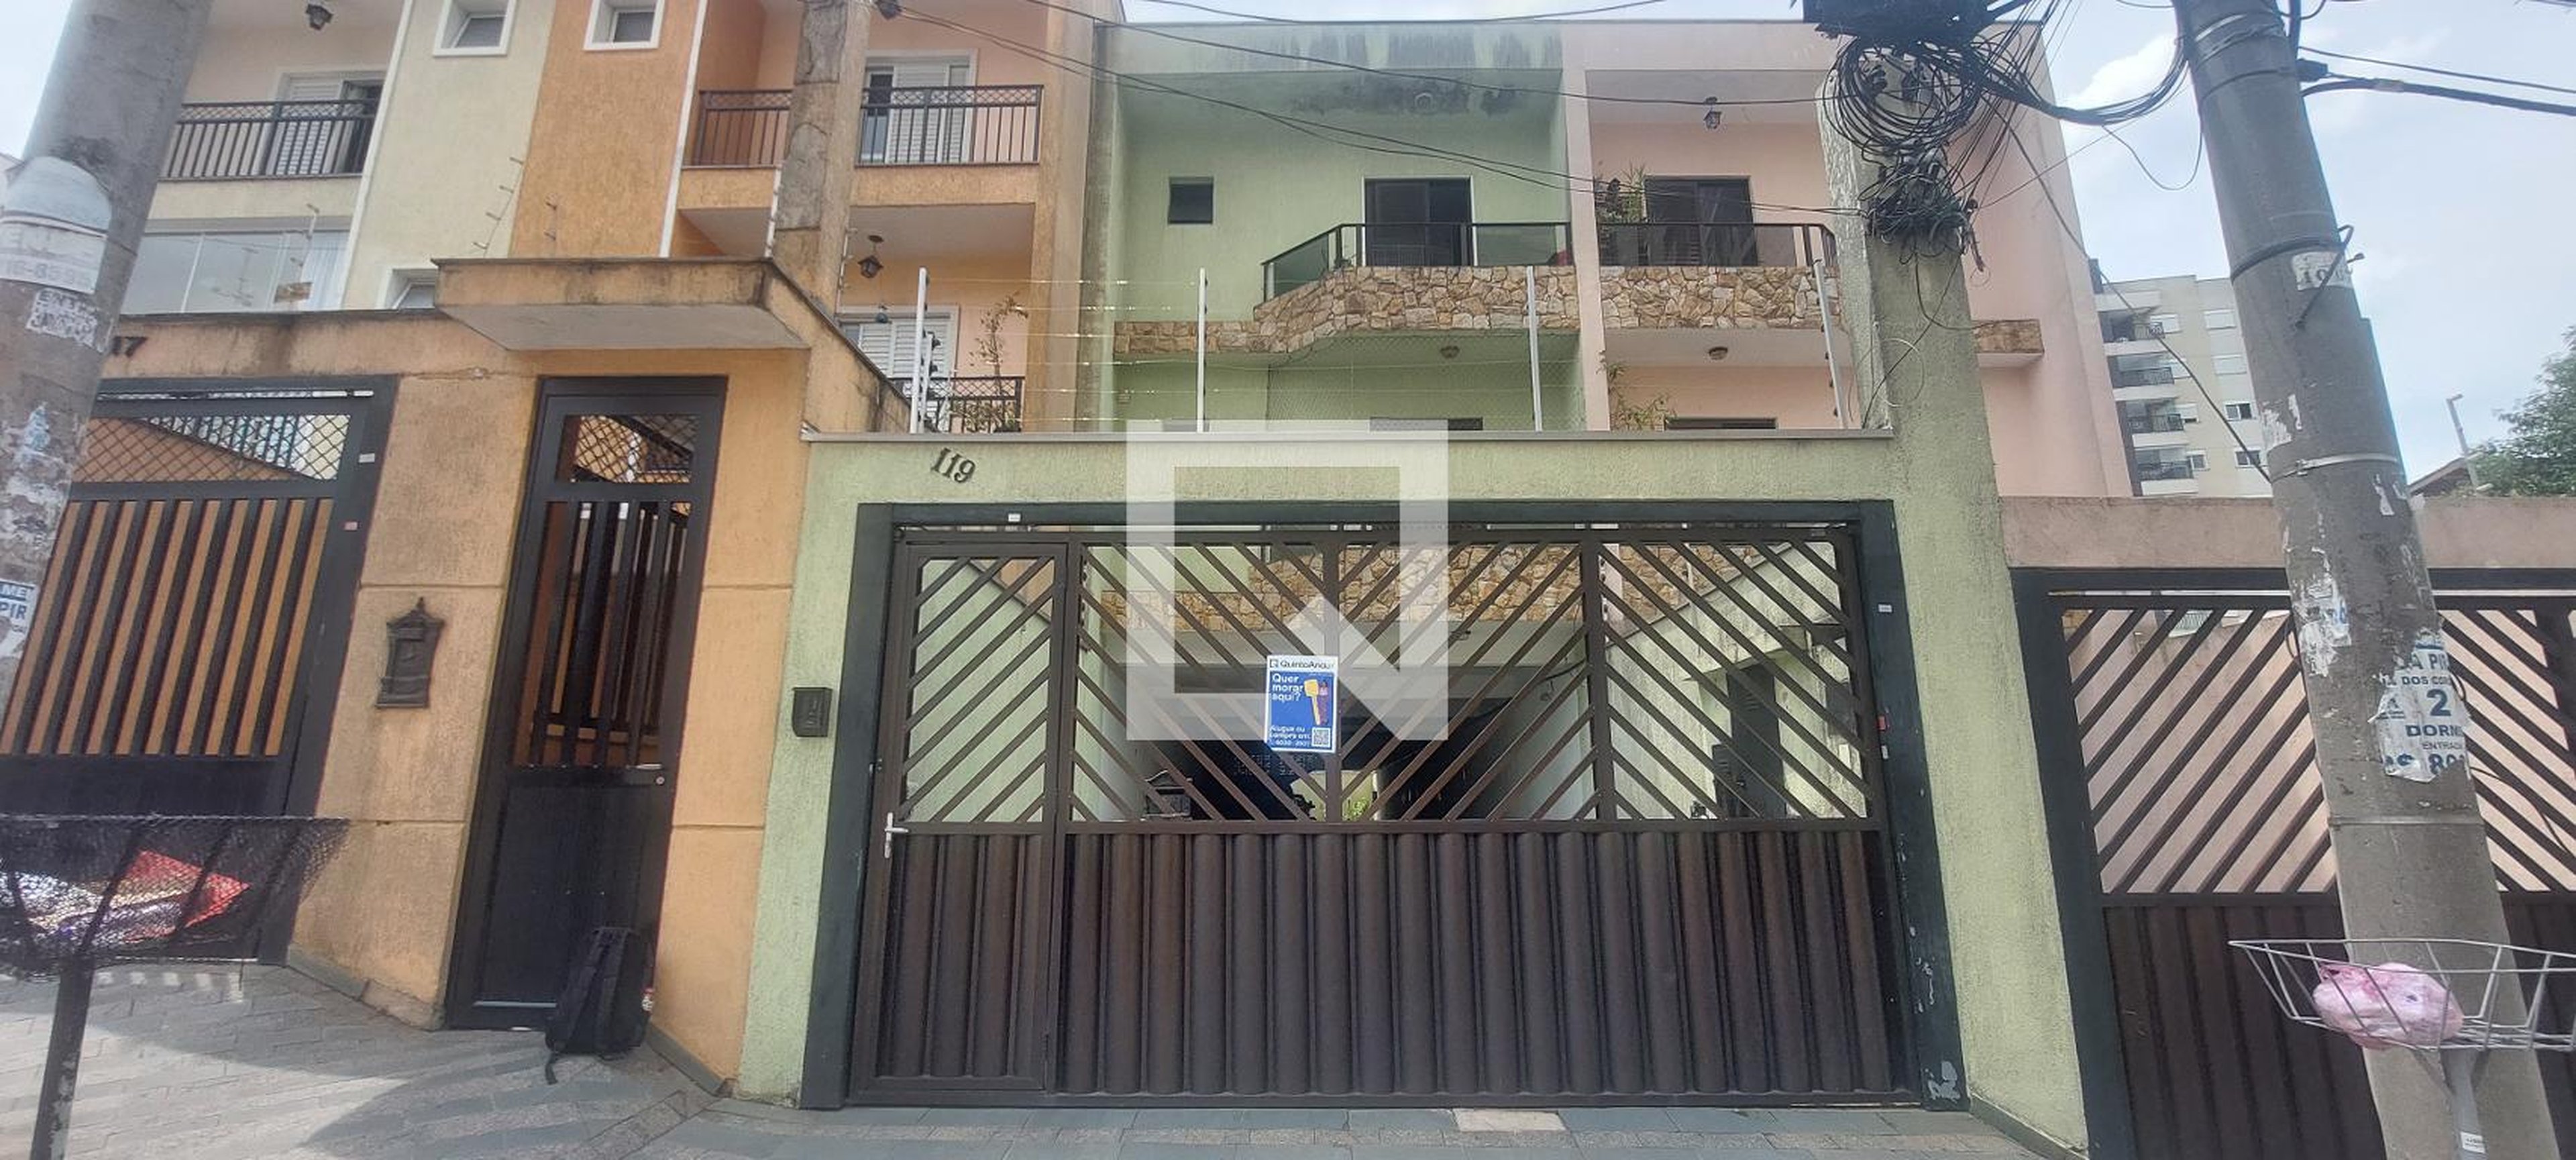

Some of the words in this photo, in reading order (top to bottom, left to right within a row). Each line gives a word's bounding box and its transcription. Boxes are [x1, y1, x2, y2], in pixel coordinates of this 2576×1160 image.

[930, 447, 975, 483] 119
[1272, 673, 1299, 683] Quer
[2402, 676, 2429, 685] DOS
[1273, 684, 1303, 692] morar
[1272, 692, 1301, 704] aqui?
[2426, 688, 2452, 717] 2
